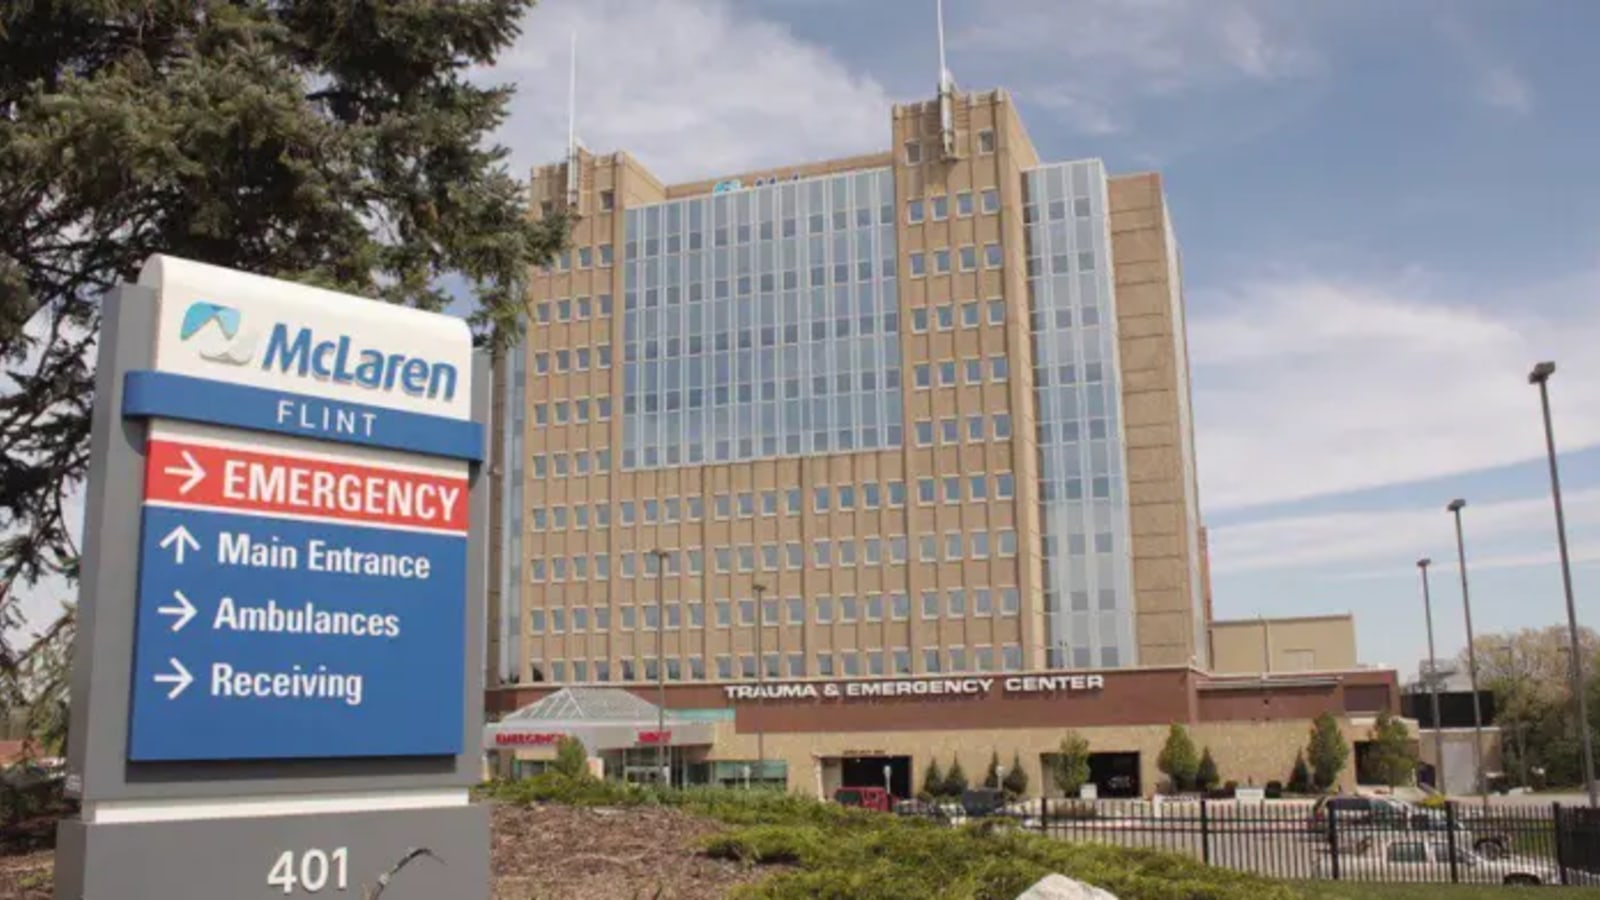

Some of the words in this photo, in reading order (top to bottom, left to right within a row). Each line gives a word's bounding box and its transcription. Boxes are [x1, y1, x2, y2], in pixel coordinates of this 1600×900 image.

[261, 322, 458, 402] McLaren
[276, 400, 378, 437] FLINT
[222, 459, 460, 522] EMERGENCY
[217, 531, 298, 569] Main
[307, 540, 431, 579] Entrance
[212, 597, 400, 638] Ambulances
[210, 662, 363, 706] Receiving
[724, 684, 818, 699] TRAUMA
[823, 683, 841, 697] &
[846, 679, 994, 698] EMERGENCY
[1005, 675, 1104, 692] CENTER
[267, 846, 349, 893] 401
